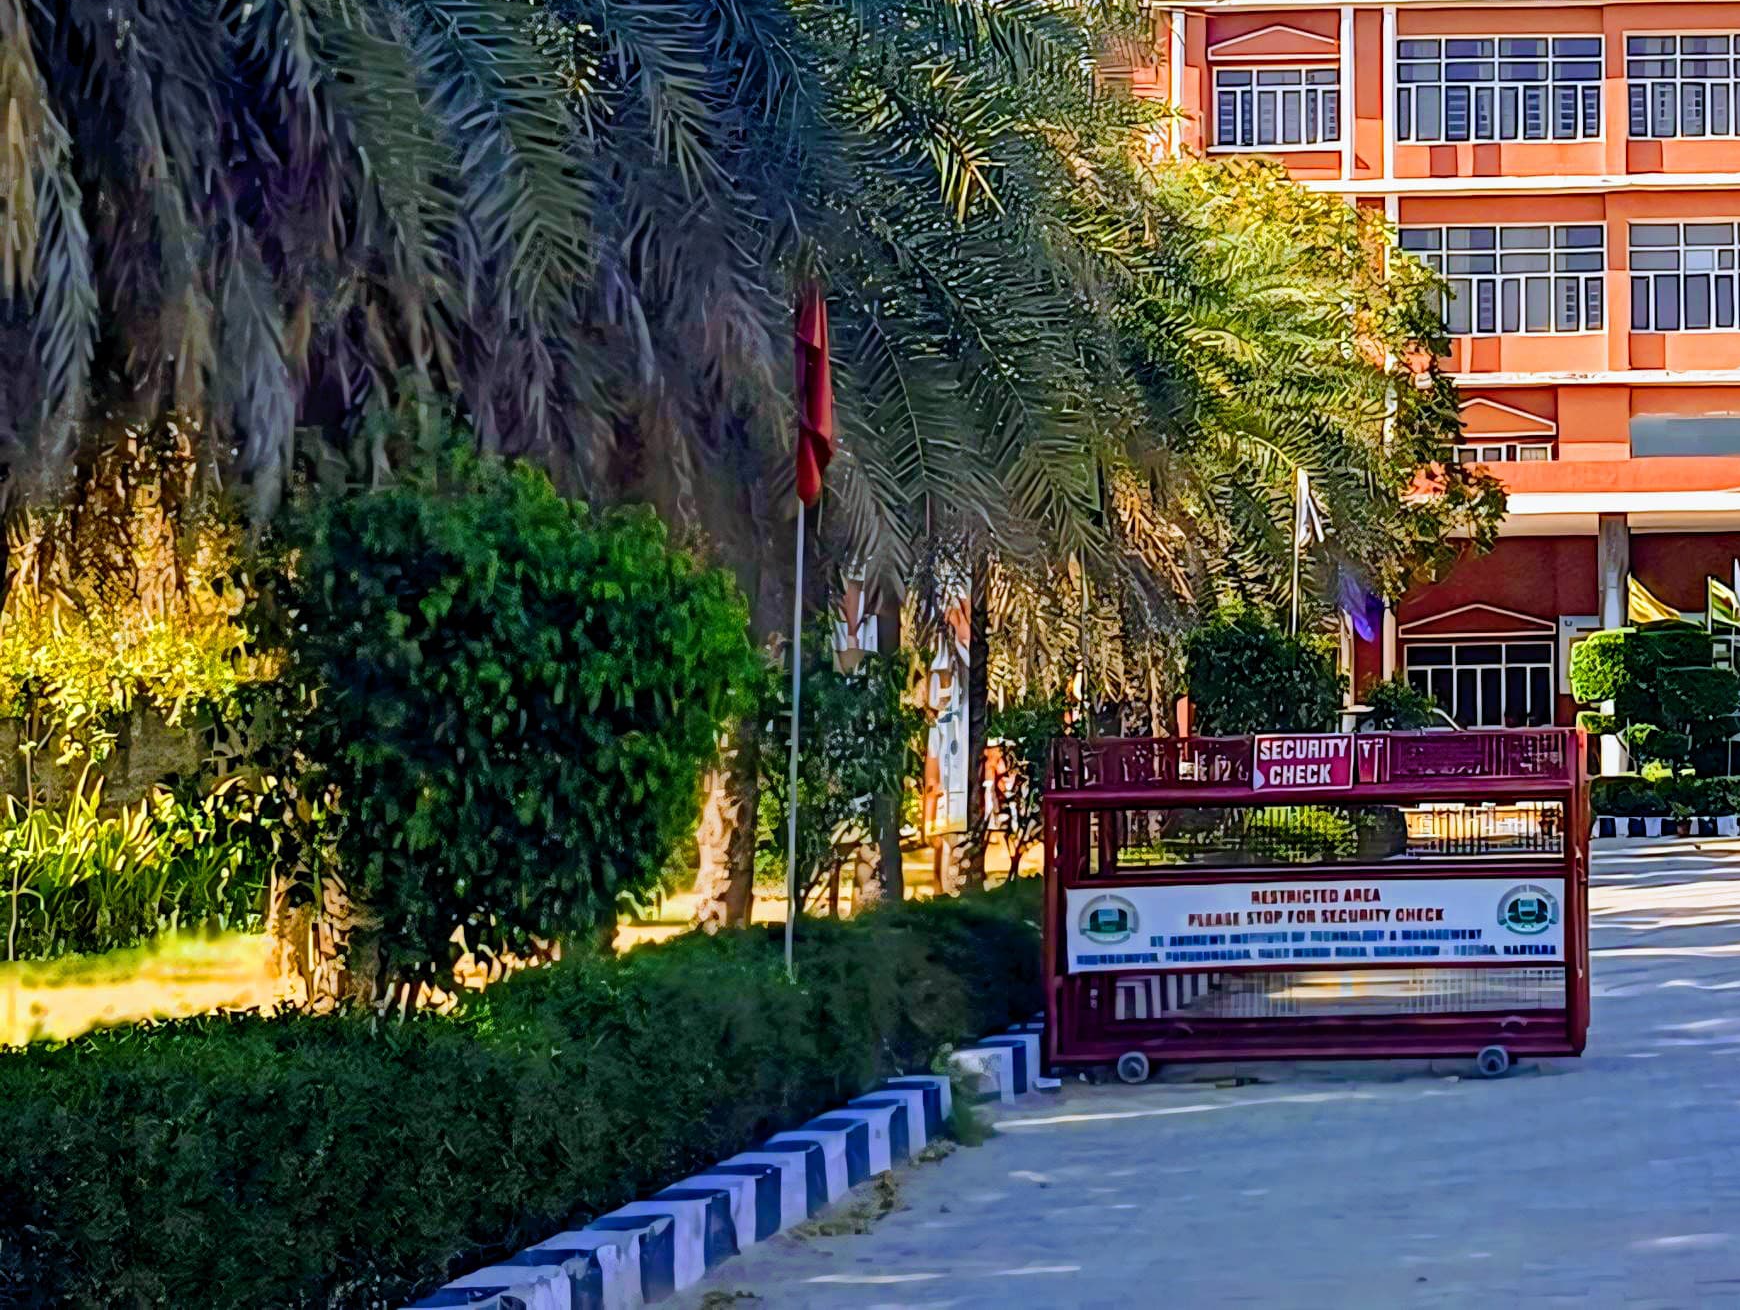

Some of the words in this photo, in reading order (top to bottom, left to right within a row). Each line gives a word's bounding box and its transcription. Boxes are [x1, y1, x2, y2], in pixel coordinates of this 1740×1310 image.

[1259, 738, 1349, 760] SECURITY
[1269, 764, 1332, 785] CHECK
[1251, 889, 1339, 904] RESTRICTED
[1344, 888, 1381, 903] AREA
[1395, 907, 1445, 922] CHECK
